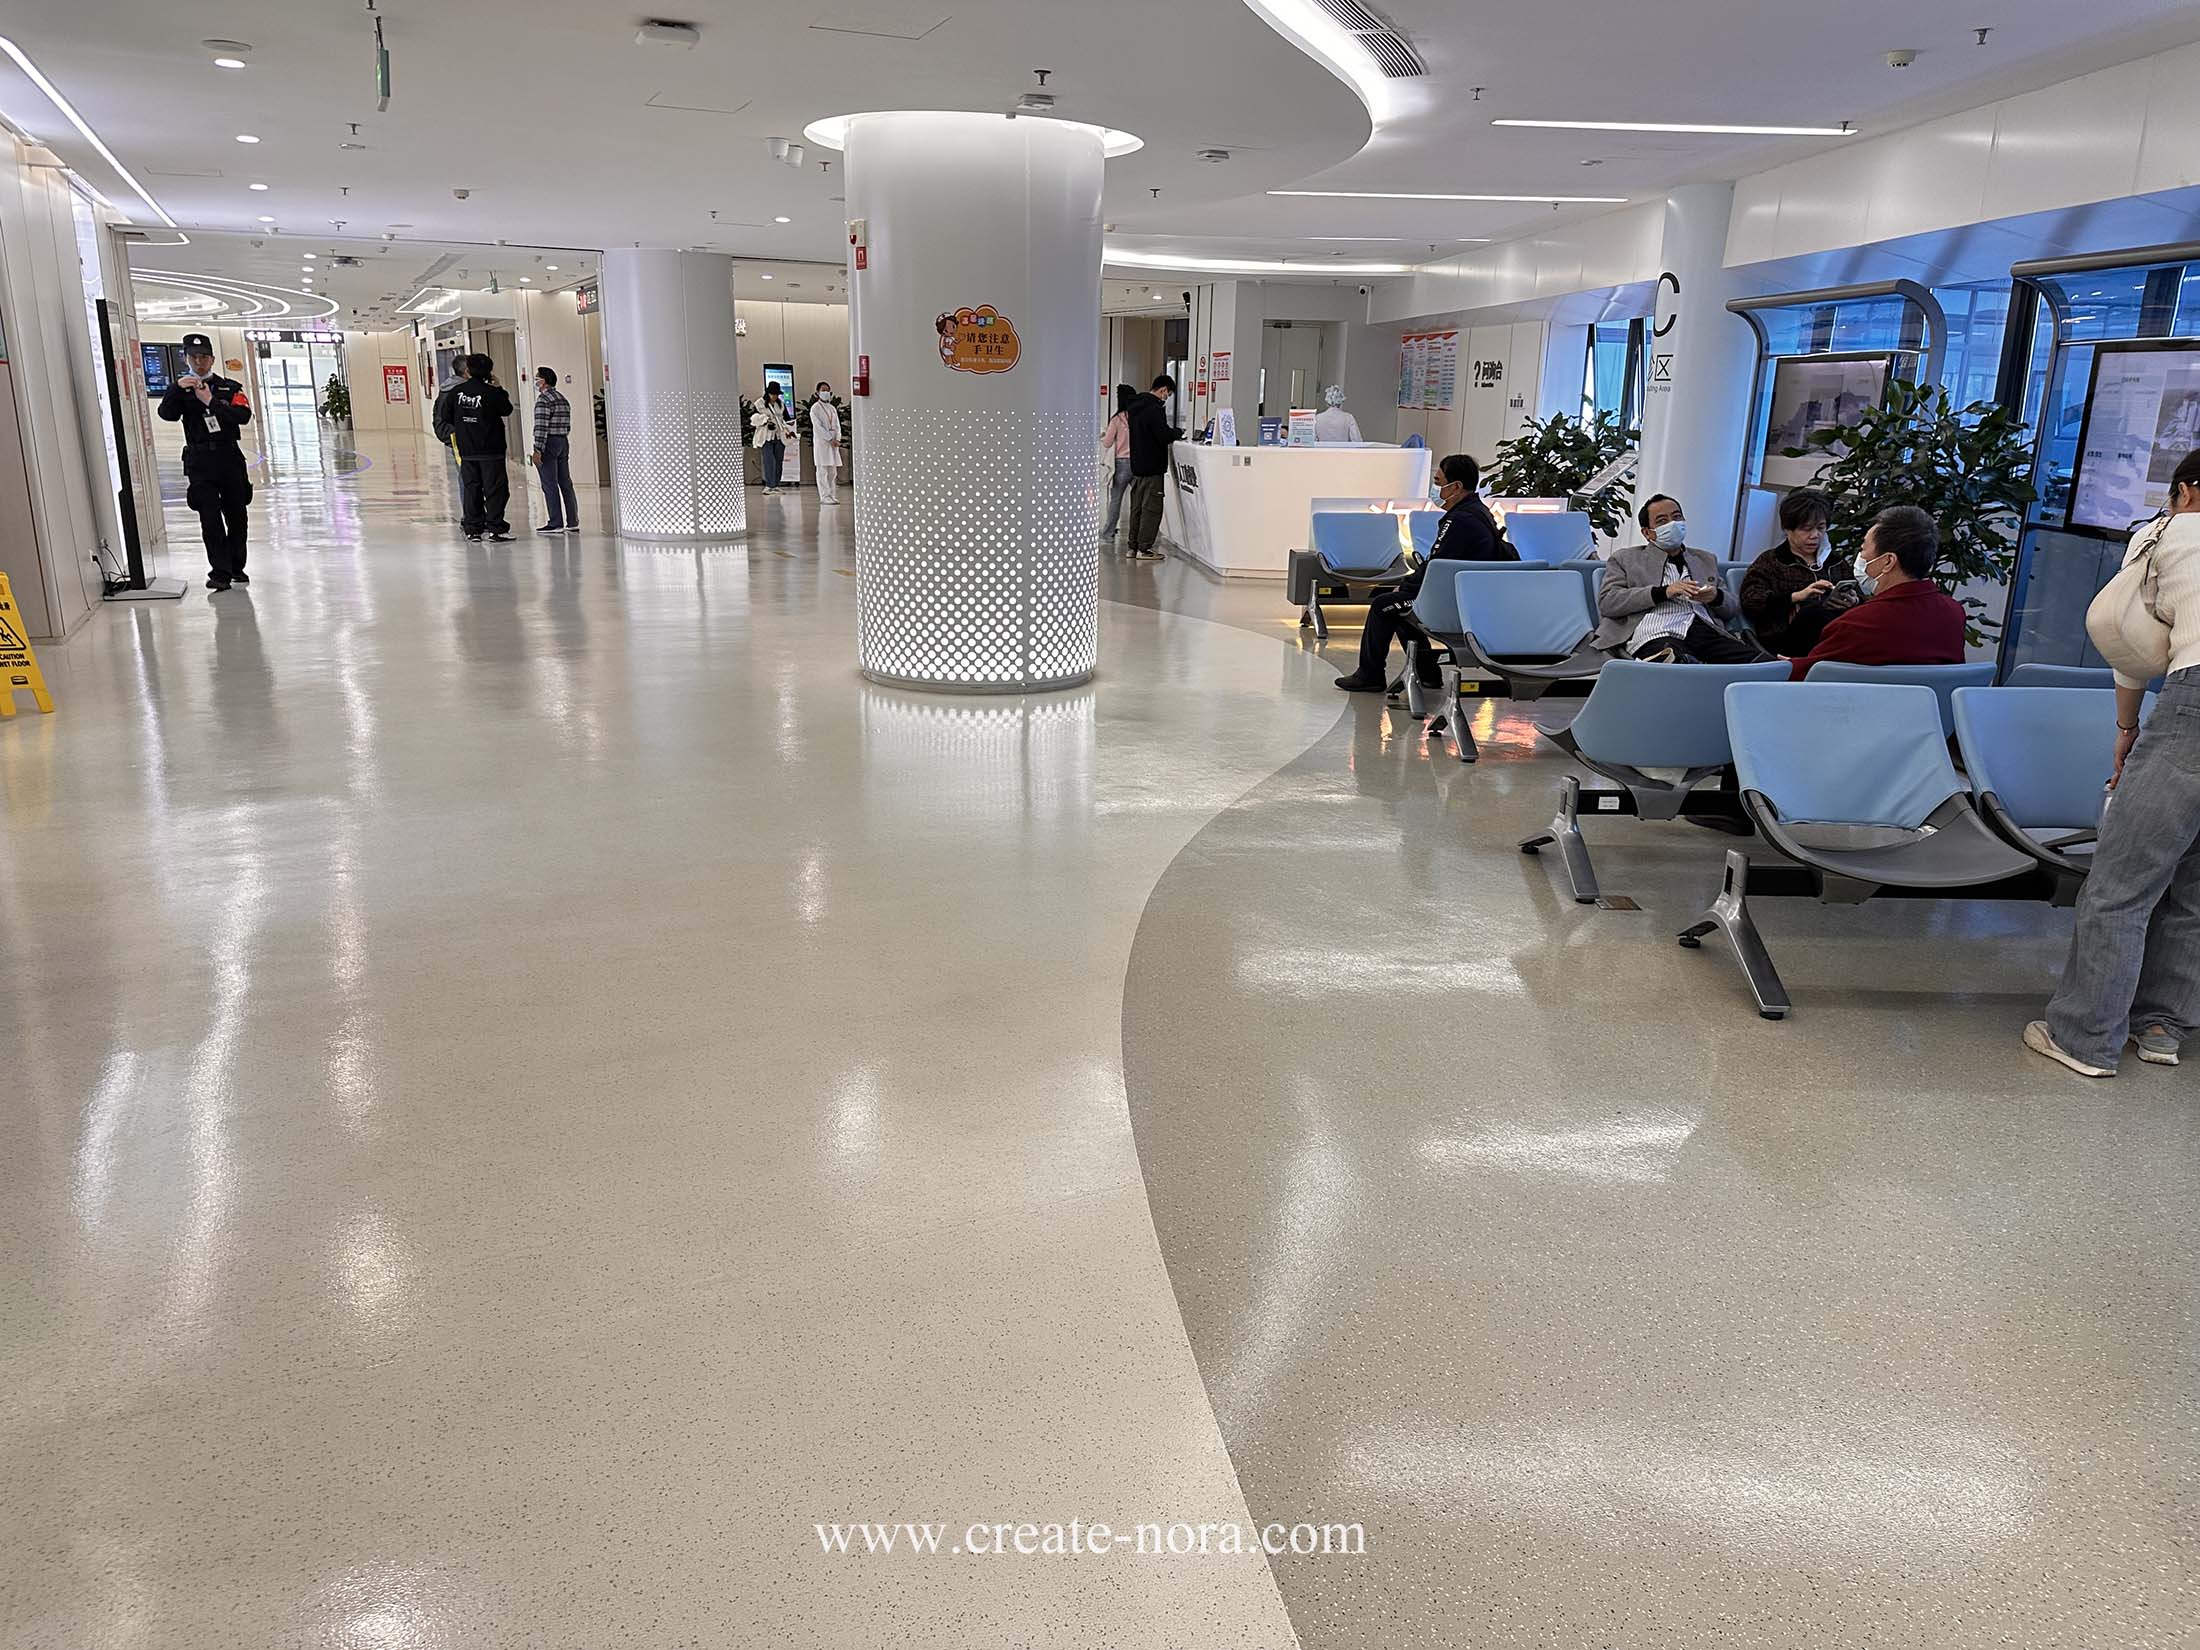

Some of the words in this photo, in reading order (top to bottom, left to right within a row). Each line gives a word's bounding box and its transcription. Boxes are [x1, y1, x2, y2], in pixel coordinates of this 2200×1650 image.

[1653, 272, 1680, 337] C
[966, 332, 1010, 344] 请您注意
[974, 345, 1004, 355] 手卫生
